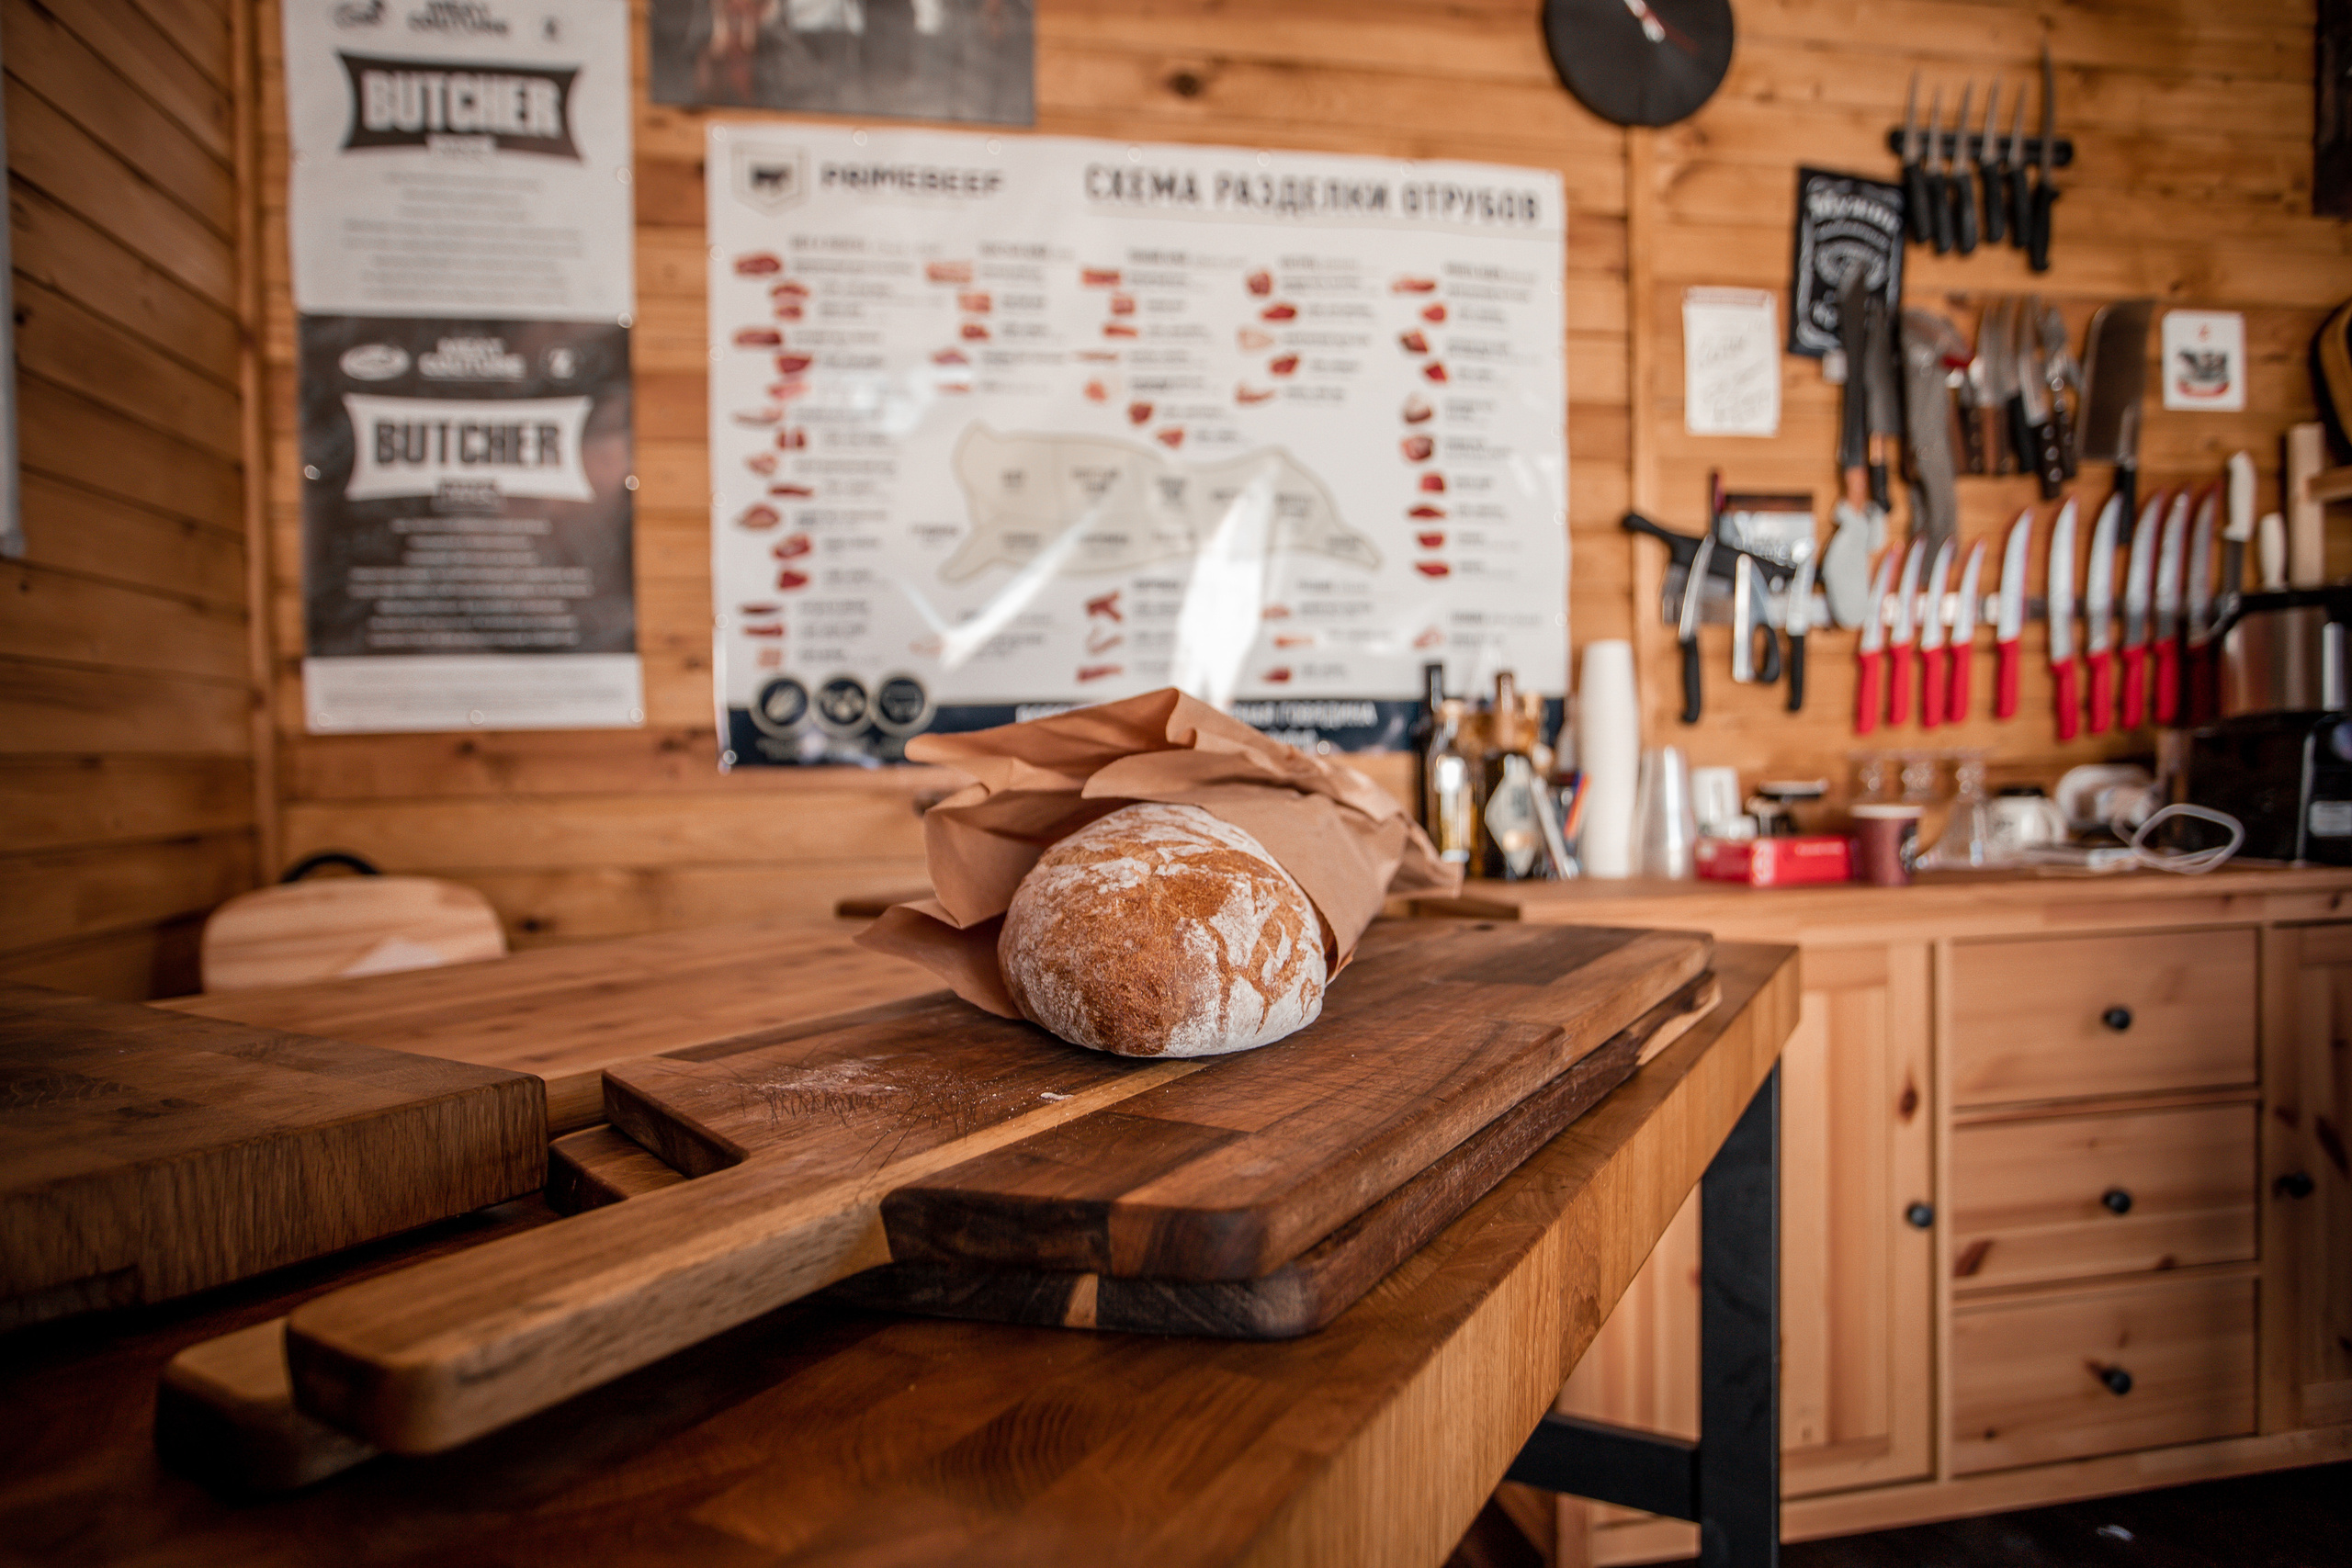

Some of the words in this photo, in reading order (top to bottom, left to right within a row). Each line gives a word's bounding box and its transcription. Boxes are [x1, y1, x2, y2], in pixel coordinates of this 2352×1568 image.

[361, 71, 561, 138] BUTCHER
[1084, 164, 1202, 206] СХЕМА
[1215, 171, 1388, 219] РАЗДЕЛКИ
[1402, 182, 1540, 224] ОТРУБОВ
[376, 423, 560, 465] BUTCHER
